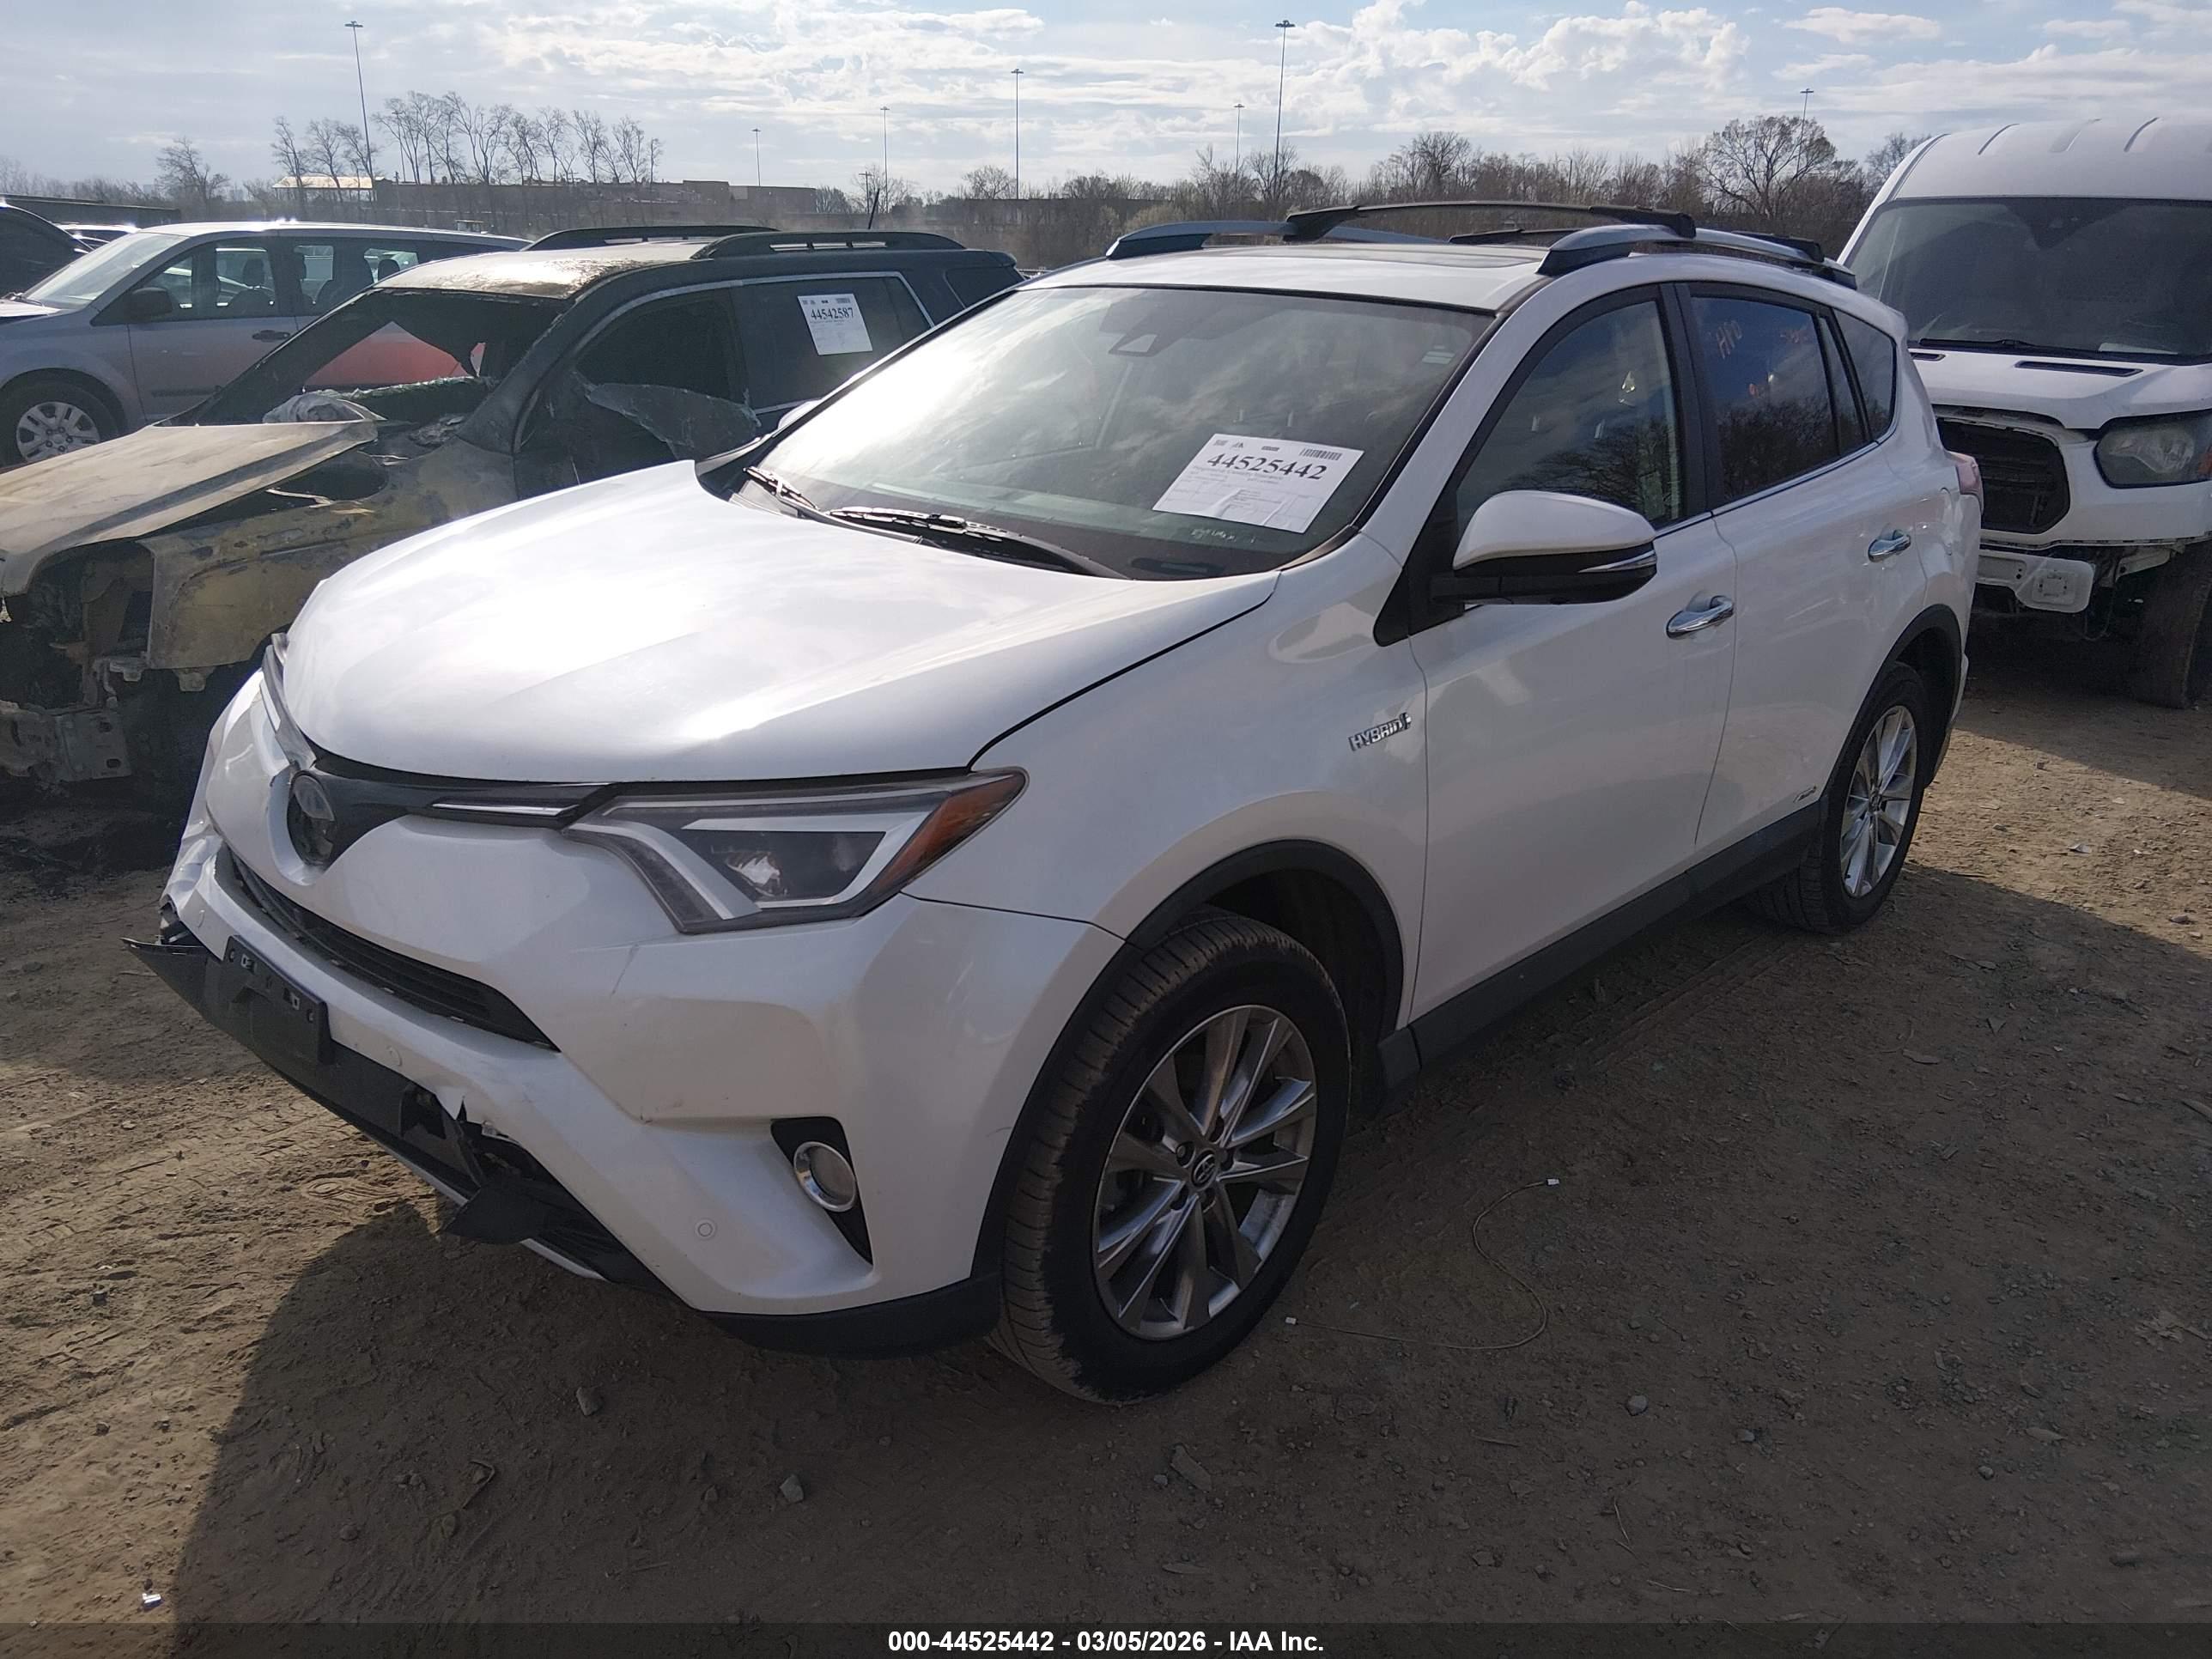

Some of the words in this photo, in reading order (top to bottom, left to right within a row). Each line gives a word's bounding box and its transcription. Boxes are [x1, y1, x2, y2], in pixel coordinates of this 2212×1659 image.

[811, 307, 854, 320] 44542587
[1206, 453, 1328, 481] 44525442
[1348, 714, 1409, 752] HYBRID
